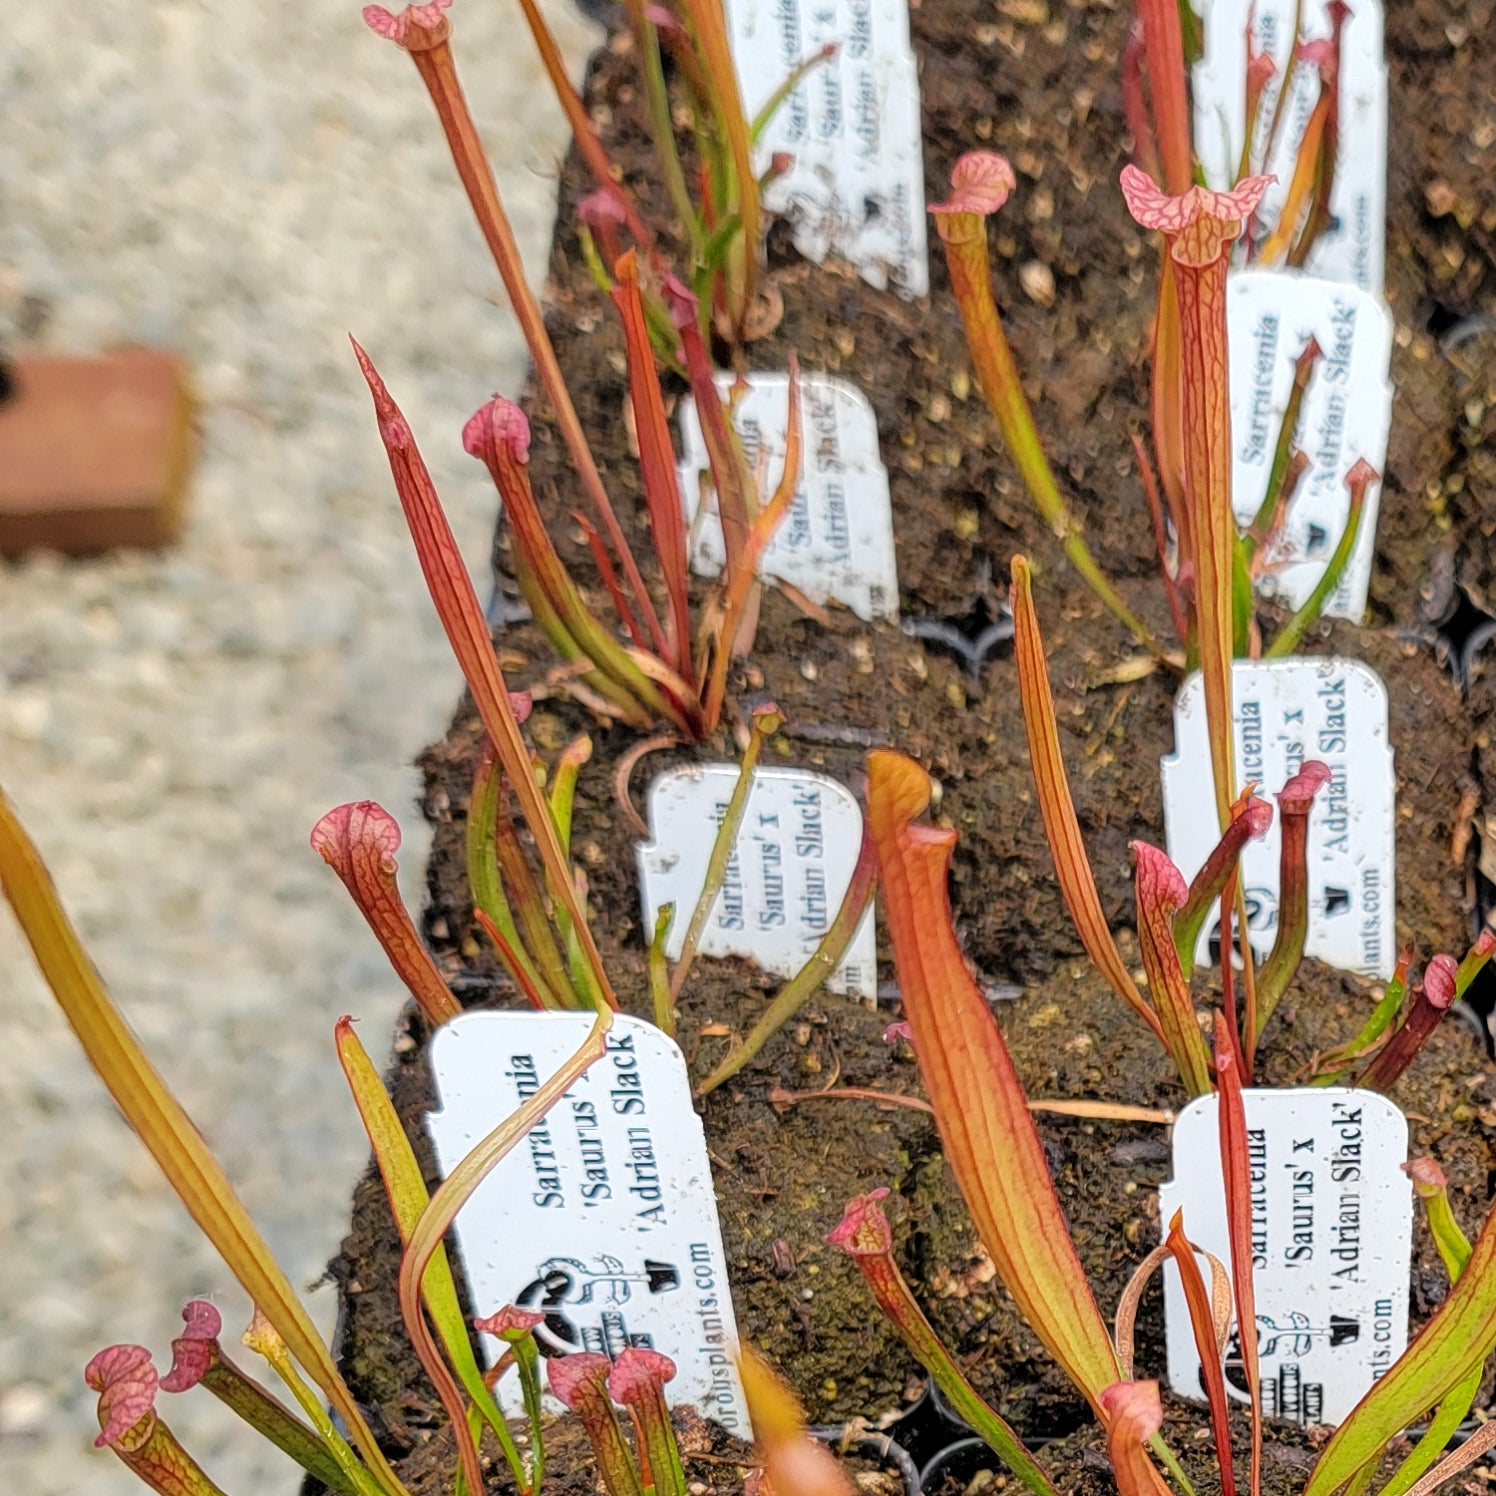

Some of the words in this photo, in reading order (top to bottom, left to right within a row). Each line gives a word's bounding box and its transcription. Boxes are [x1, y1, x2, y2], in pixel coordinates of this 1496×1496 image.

[1238, 314, 1280, 466] Sarracenia
[1283, 708, 1305, 726] x
[1317, 671, 1348, 754] Slack'
[759, 812, 780, 828] x
[792, 784, 823, 858] Slack'
[752, 835, 785, 931] 'Saurus'
[605, 1033, 646, 1116] Slack
[561, 1093, 613, 1208] 'Saurus'
[625, 1126, 669, 1233] 'Adrian
[1292, 1137, 1315, 1154] x
[1330, 1101, 1363, 1183] Slack'
[1284, 1163, 1314, 1269] 'Saurus'
[1330, 1193, 1361, 1291] 'Adrian
